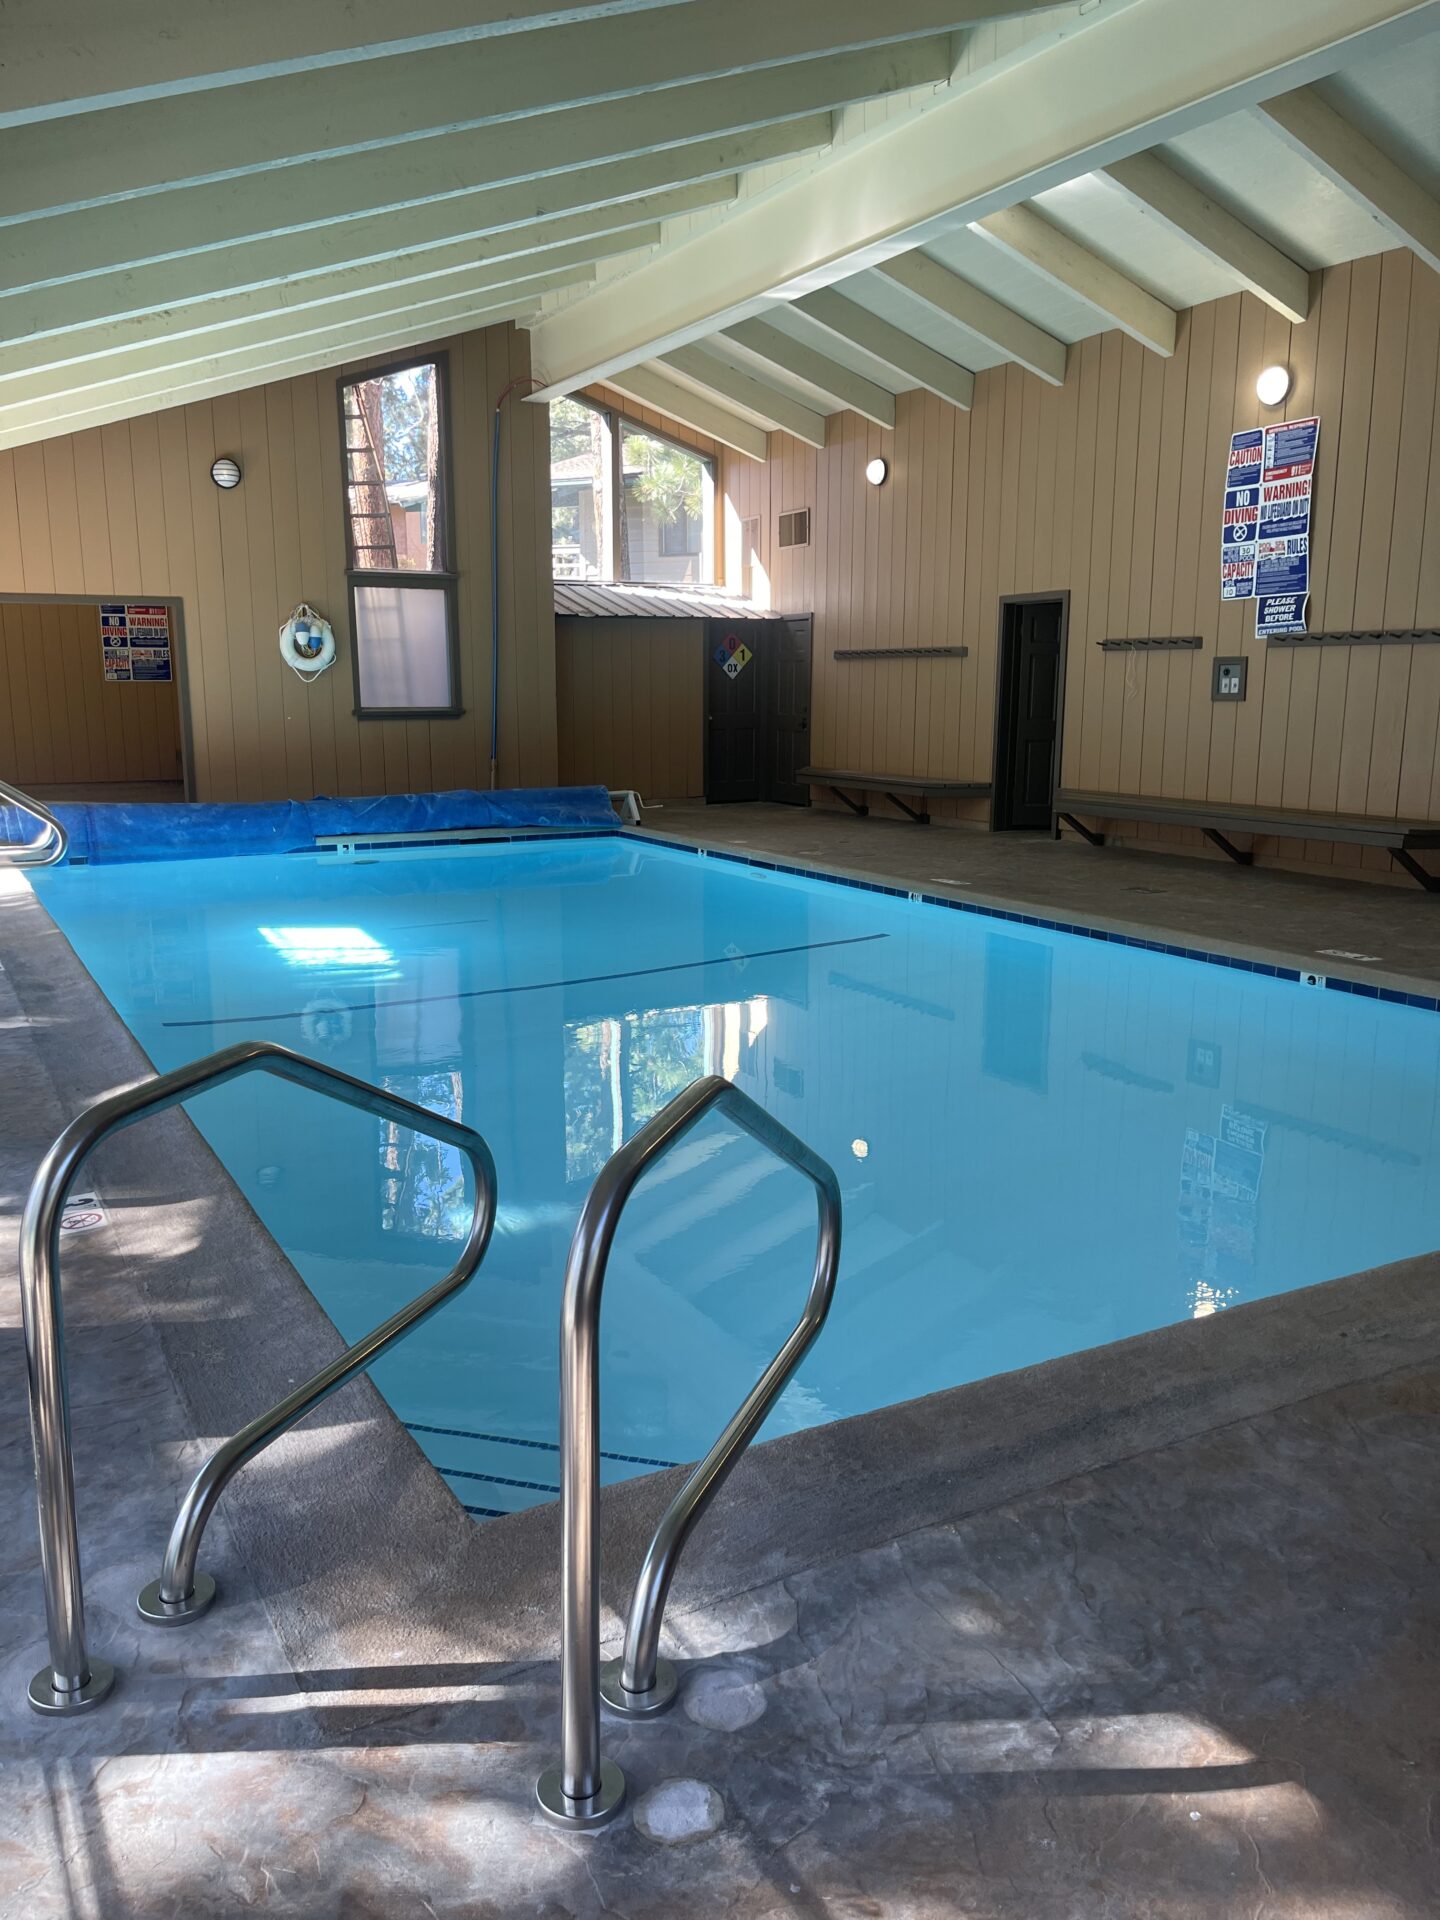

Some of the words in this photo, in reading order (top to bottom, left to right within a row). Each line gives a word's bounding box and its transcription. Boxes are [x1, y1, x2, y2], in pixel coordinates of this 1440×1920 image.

[1230, 446, 1262, 466] CAUTION
[1263, 479, 1312, 502] WARNING!
[1236, 490, 1250, 507] NO
[1224, 506, 1258, 525] DIVING
[1241, 547, 1251, 555] 30
[1287, 537, 1307, 555] RULES
[1223, 561, 1254, 579] CAPACITY
[1266, 597, 1297, 606] PLEASE
[1264, 605, 1296, 614] SHOWER
[109, 616, 120, 626] NO
[129, 617, 168, 627] WARNING!
[1265, 613, 1295, 622] BEFORE
[102, 627, 127, 636] DIVING
[1259, 627, 1287, 635] ENTERING
[729, 638, 735, 650] 0
[740, 649, 745, 661] 1
[728, 664, 738, 673] OX
